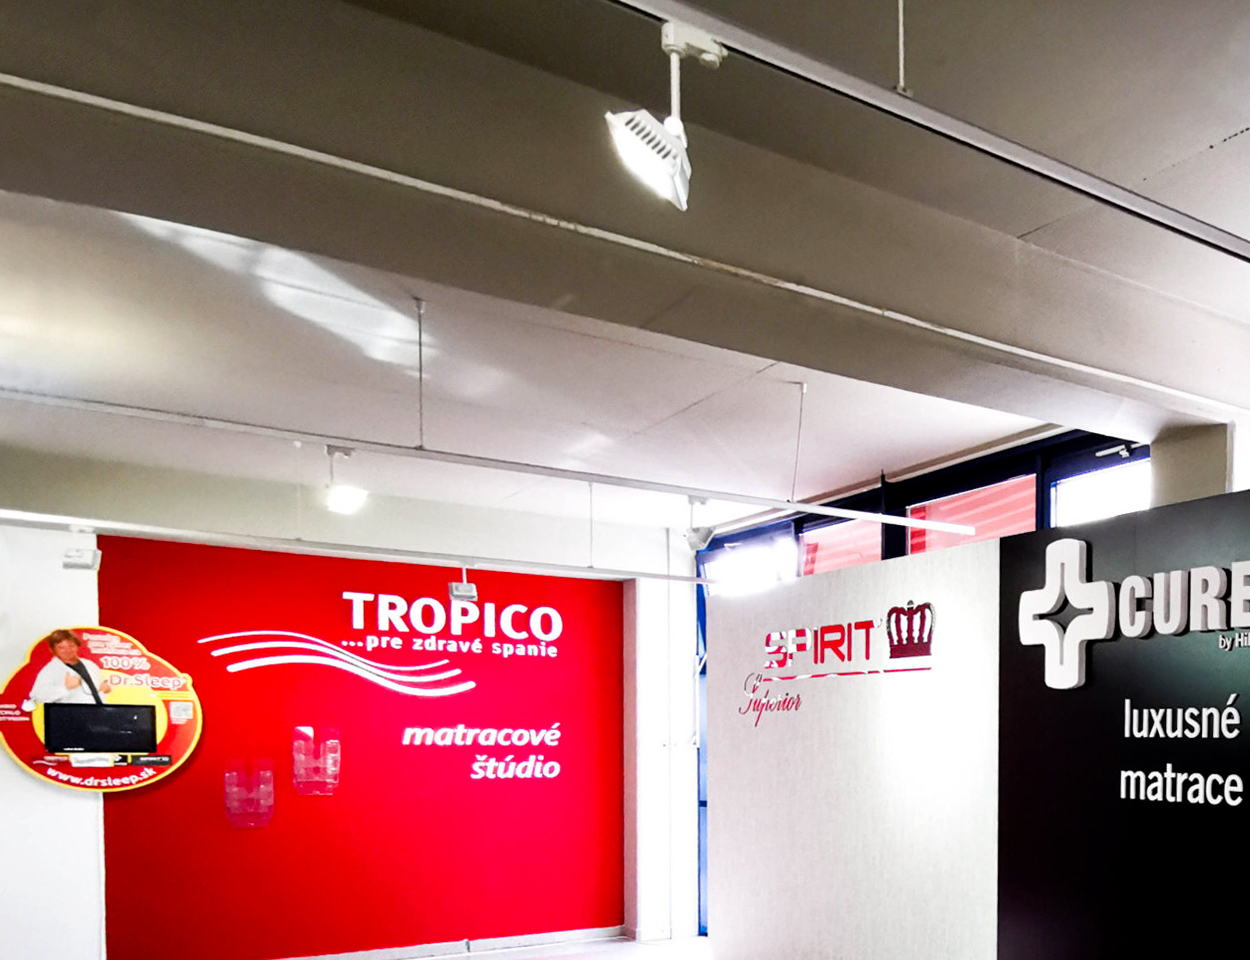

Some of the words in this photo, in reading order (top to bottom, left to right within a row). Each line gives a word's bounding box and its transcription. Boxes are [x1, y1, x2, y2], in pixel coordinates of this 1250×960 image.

[342, 591, 562, 641] TROPICO
[412, 636, 483, 653] zdravé
[491, 641, 558, 658] spanie
[763, 618, 882, 669] SPIRIT
[1218, 634, 1232, 651] by
[101, 656, 149, 670] 100%
[738, 672, 802, 727] Superior
[1124, 693, 1241, 739] luxusné
[402, 722, 561, 746] matracové
[46, 767, 157, 787] www.drsleep.sk
[470, 755, 561, 779] štúdio
[1120, 763, 1244, 806] matrace
